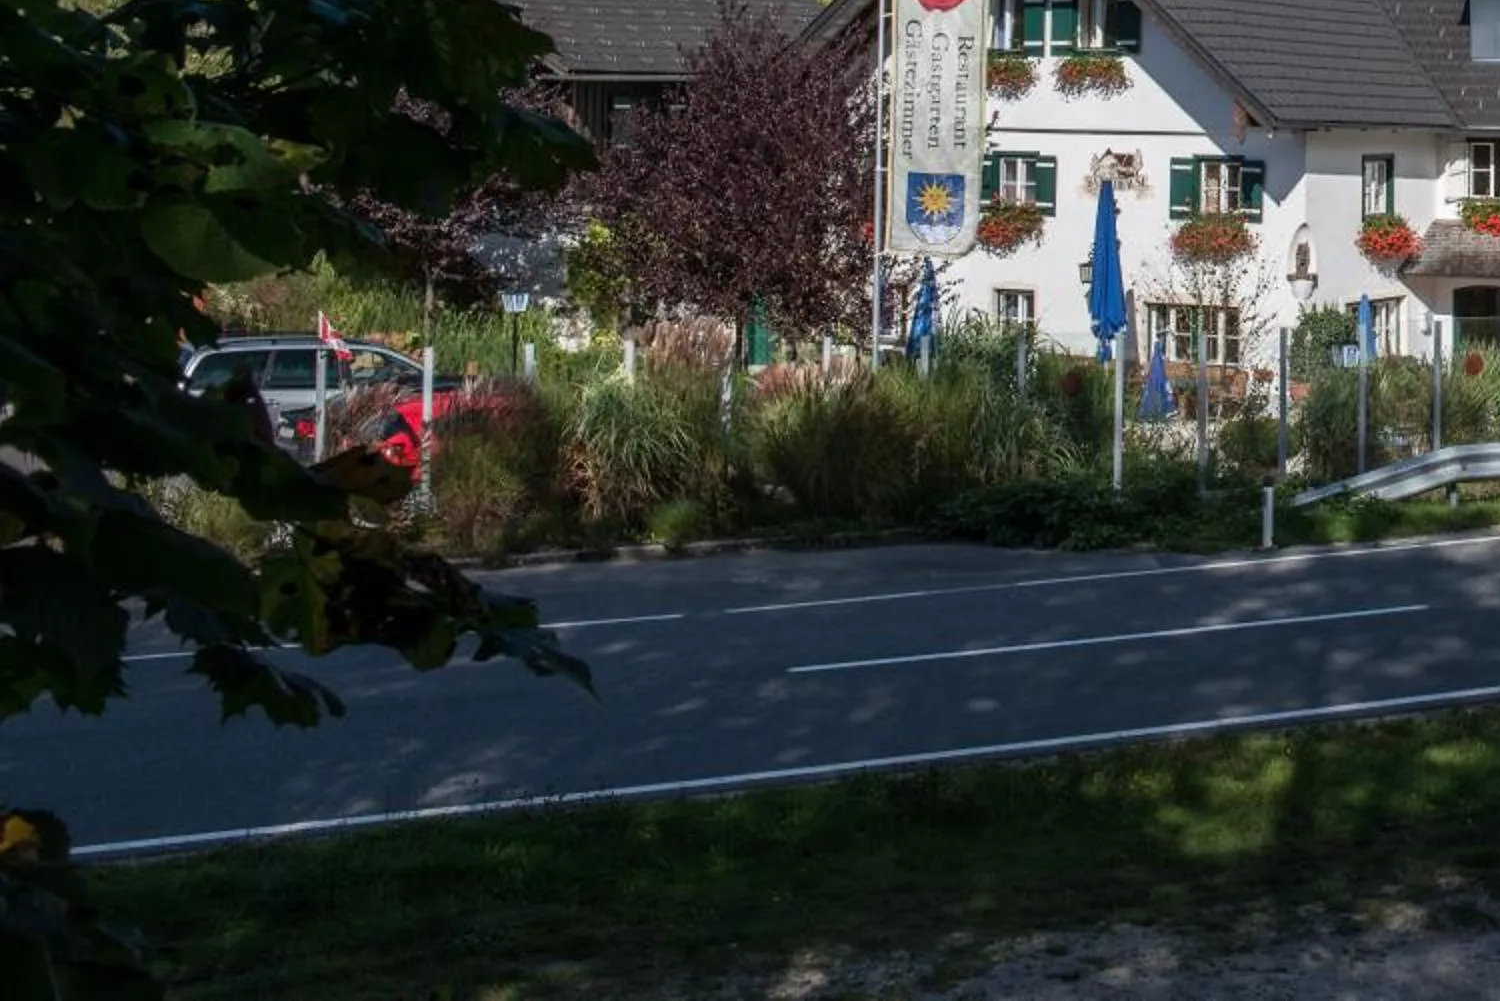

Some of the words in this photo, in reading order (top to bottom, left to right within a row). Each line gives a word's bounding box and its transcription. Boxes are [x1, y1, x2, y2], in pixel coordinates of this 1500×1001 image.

[901, 19, 923, 160] Gästezimmer
[927, 32, 951, 149] Gastgarten
[954, 35, 976, 149] Restaurant
